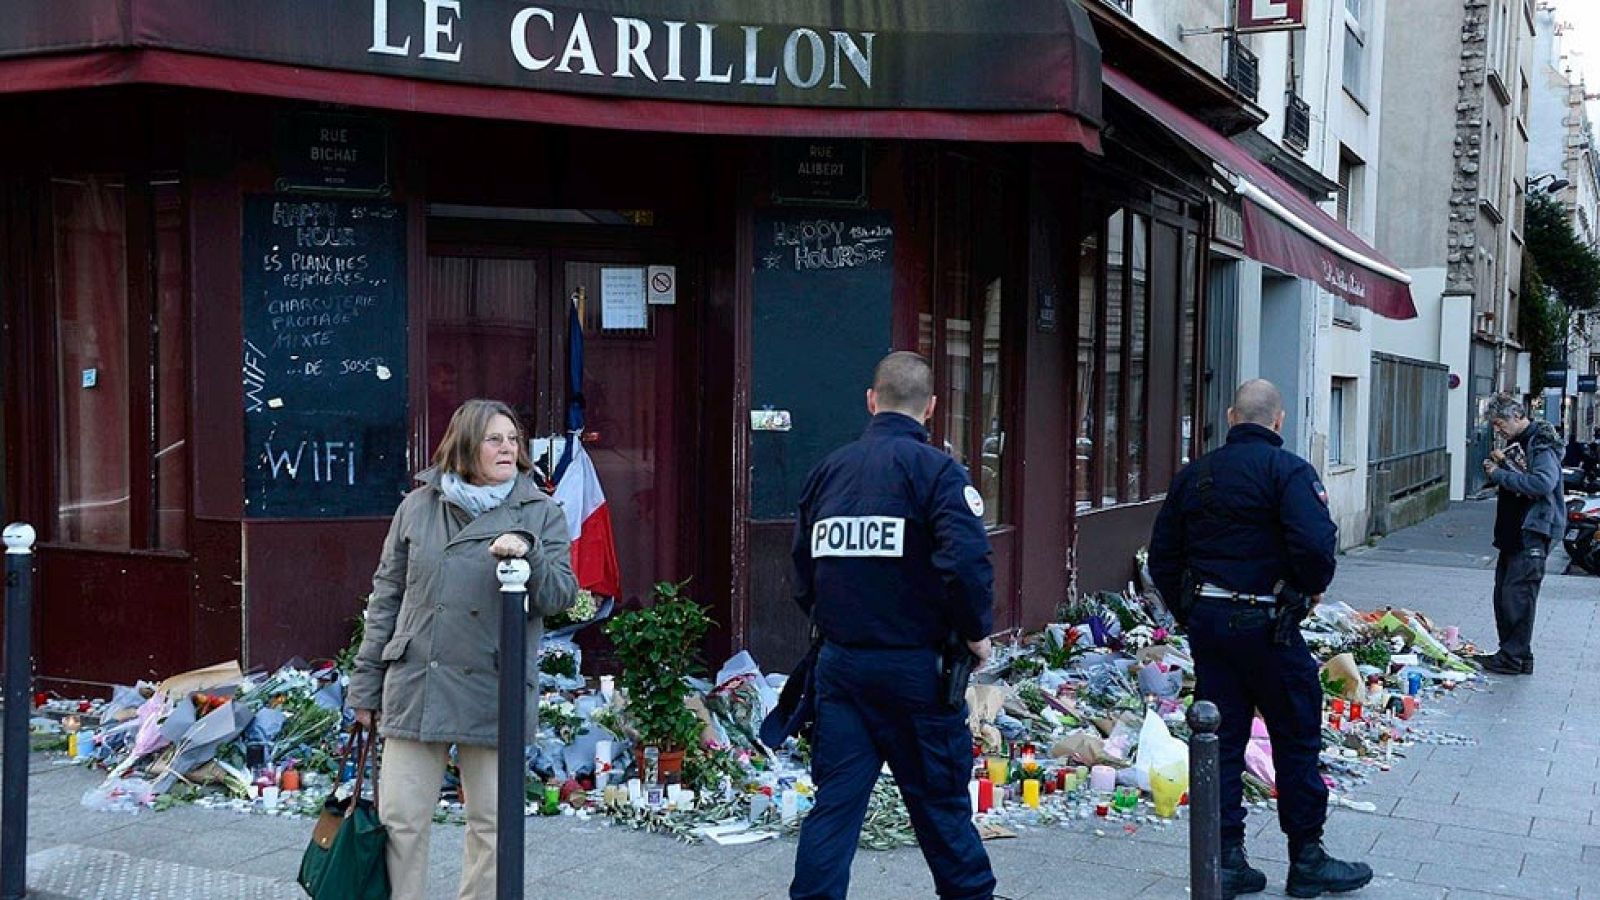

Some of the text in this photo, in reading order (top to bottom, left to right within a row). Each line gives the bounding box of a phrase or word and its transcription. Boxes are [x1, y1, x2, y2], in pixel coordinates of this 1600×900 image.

[367, 0, 877, 90] LE CARILLON
[320, 128, 349, 143] RUE
[310, 146, 357, 163] BICHAT
[809, 145, 834, 158] RUE
[798, 161, 844, 177] ALIBERT
[815, 521, 897, 551] POLICE
